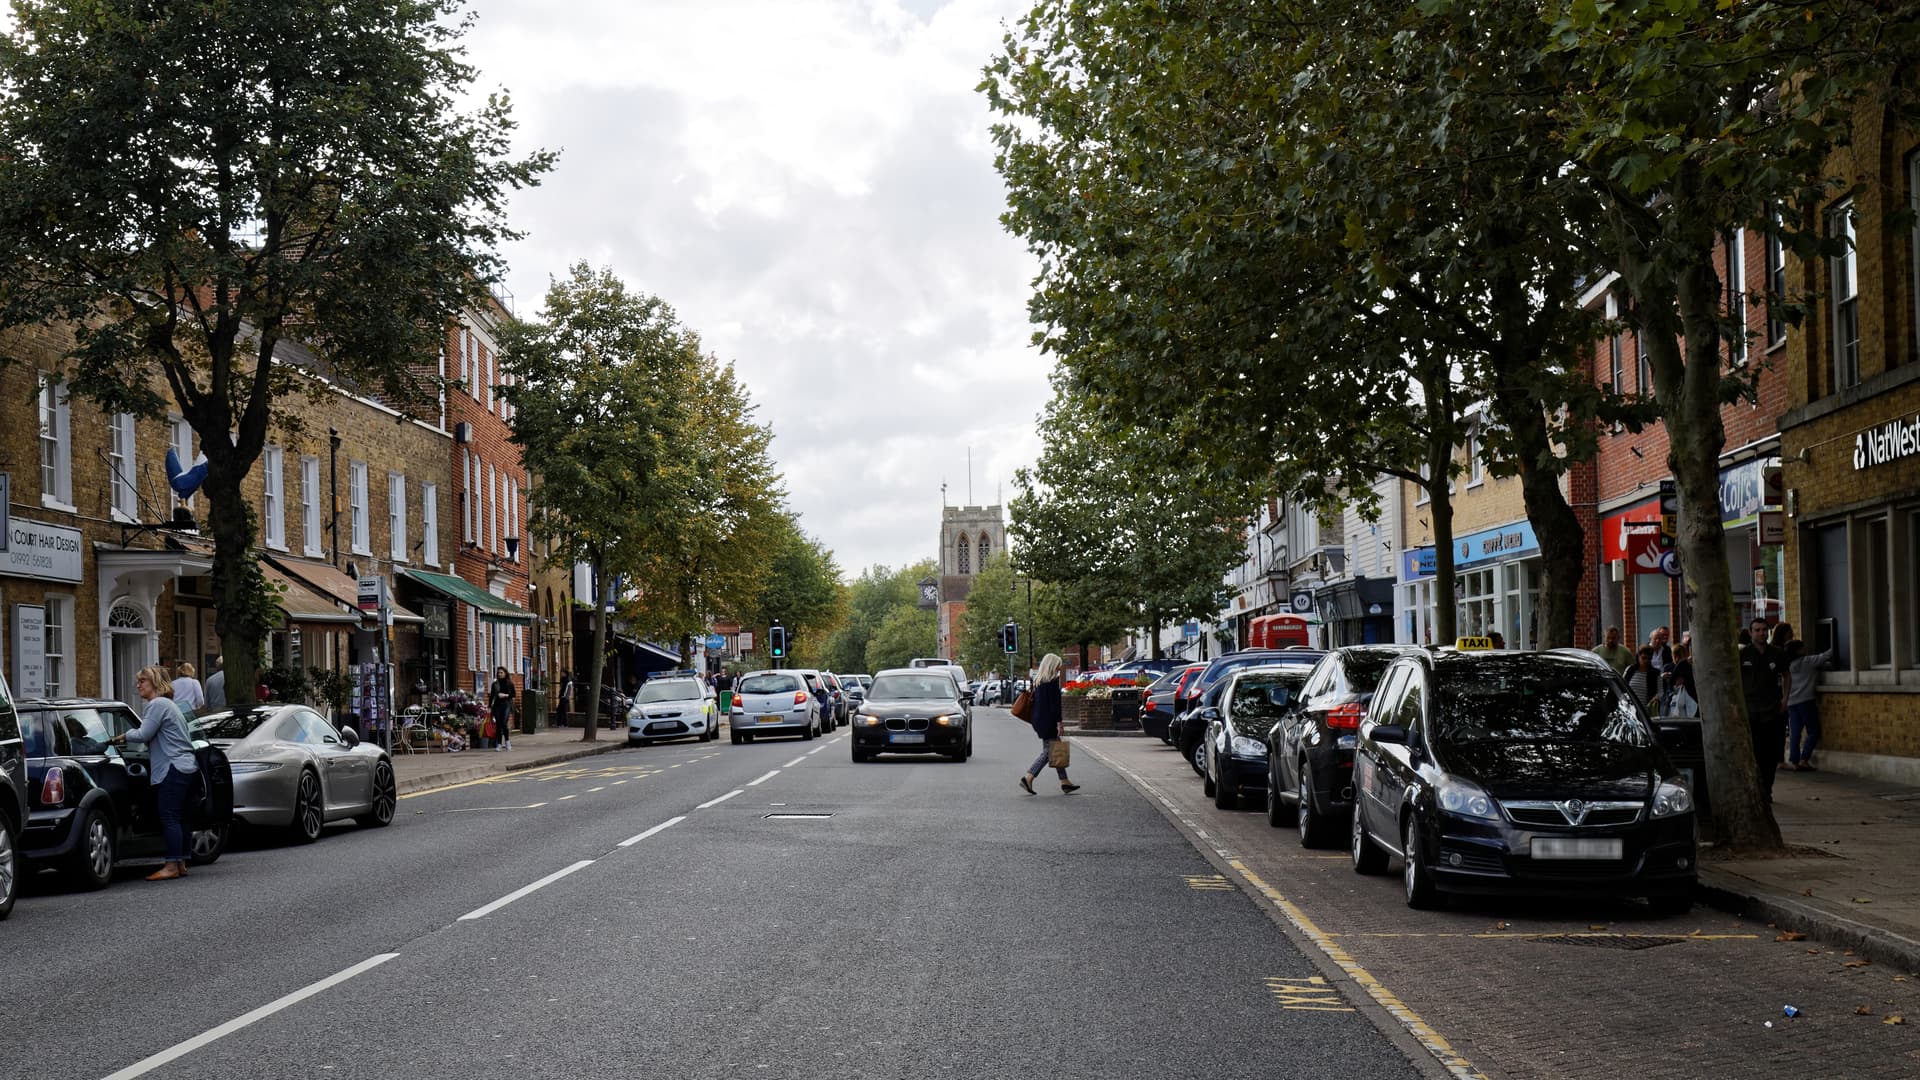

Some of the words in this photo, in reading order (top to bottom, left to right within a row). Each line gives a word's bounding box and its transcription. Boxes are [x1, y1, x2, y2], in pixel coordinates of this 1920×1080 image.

[1868, 415, 1920, 466] NatWest
[38, 533, 55, 550] HAIR
[56, 535, 80, 553] DESIGN
[1462, 638, 1489, 648] TAXI
[1263, 976, 1357, 1012] TAXI
